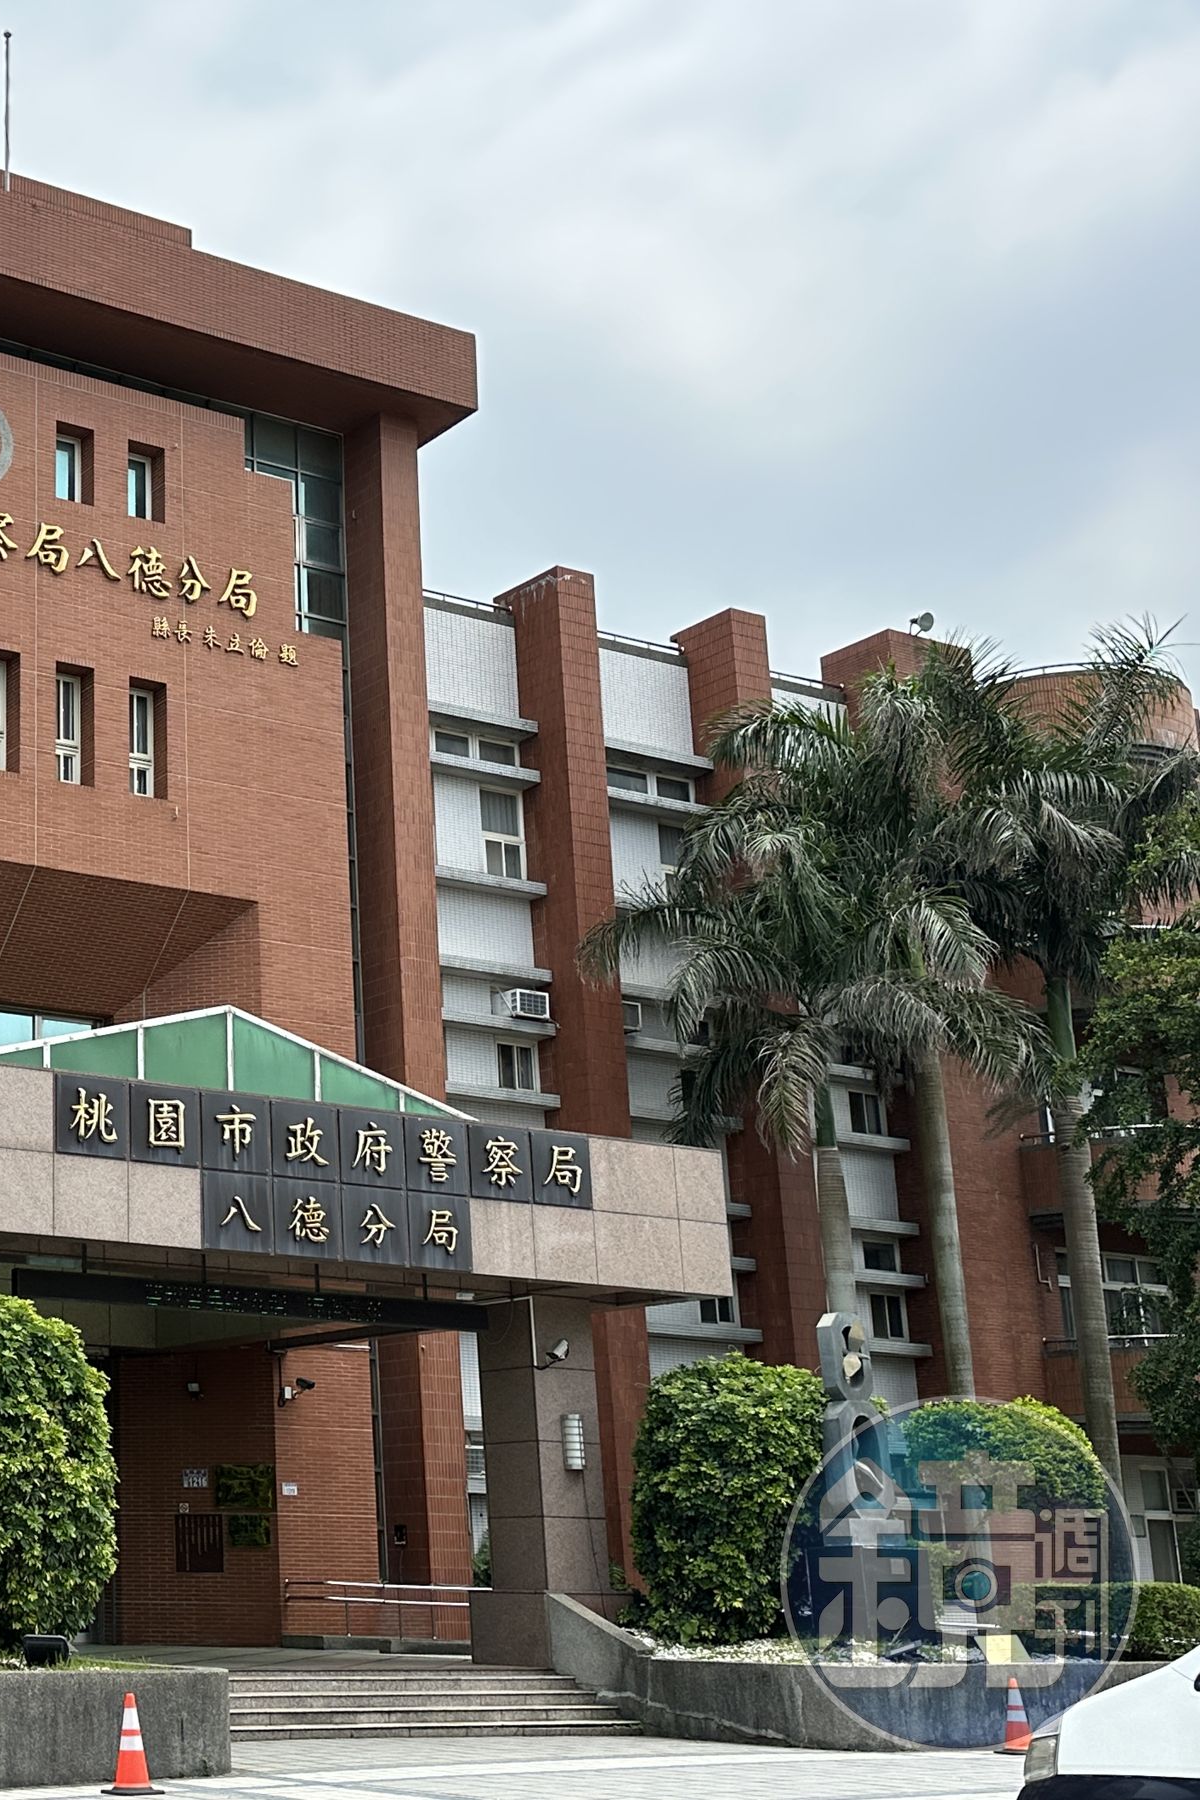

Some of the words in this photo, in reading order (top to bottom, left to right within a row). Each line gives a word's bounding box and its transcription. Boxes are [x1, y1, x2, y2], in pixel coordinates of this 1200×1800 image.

[69, 1087, 583, 1195] 桃園市政府警察局
[220, 1195, 459, 1255] 八德分局
